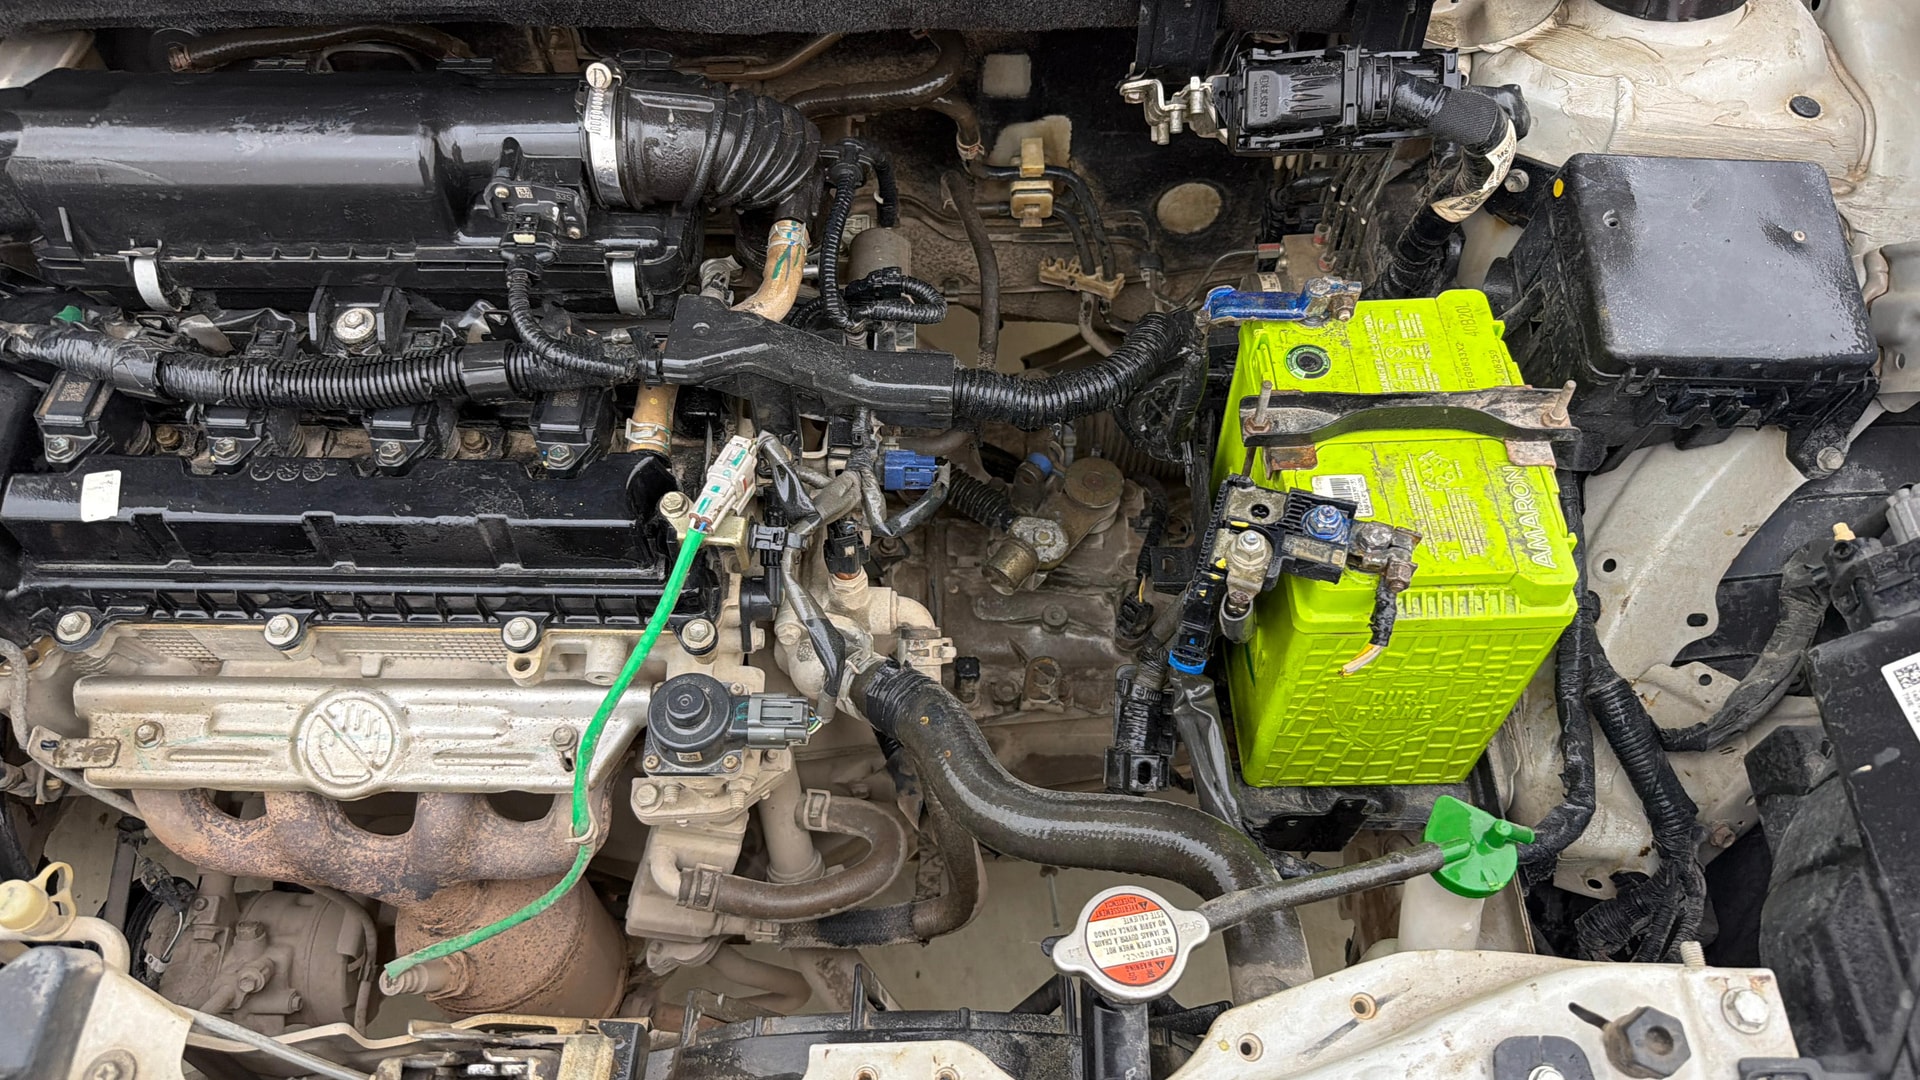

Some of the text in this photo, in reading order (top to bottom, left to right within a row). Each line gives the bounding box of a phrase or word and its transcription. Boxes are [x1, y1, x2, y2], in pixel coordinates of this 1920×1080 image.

[1455, 302, 1479, 337] 40B20L
[1502, 466, 1558, 569] AMARON
[1369, 690, 1430, 705] DURA
[1354, 704, 1440, 720] FRAME
[1149, 911, 1164, 920] ESTE
[1157, 919, 1167, 928] NO
[1117, 924, 1138, 935] NUNCA
[1135, 940, 1152, 950] OPEN
[1152, 936, 1172, 947] NEVER
[1118, 943, 1135, 953] WHEN
